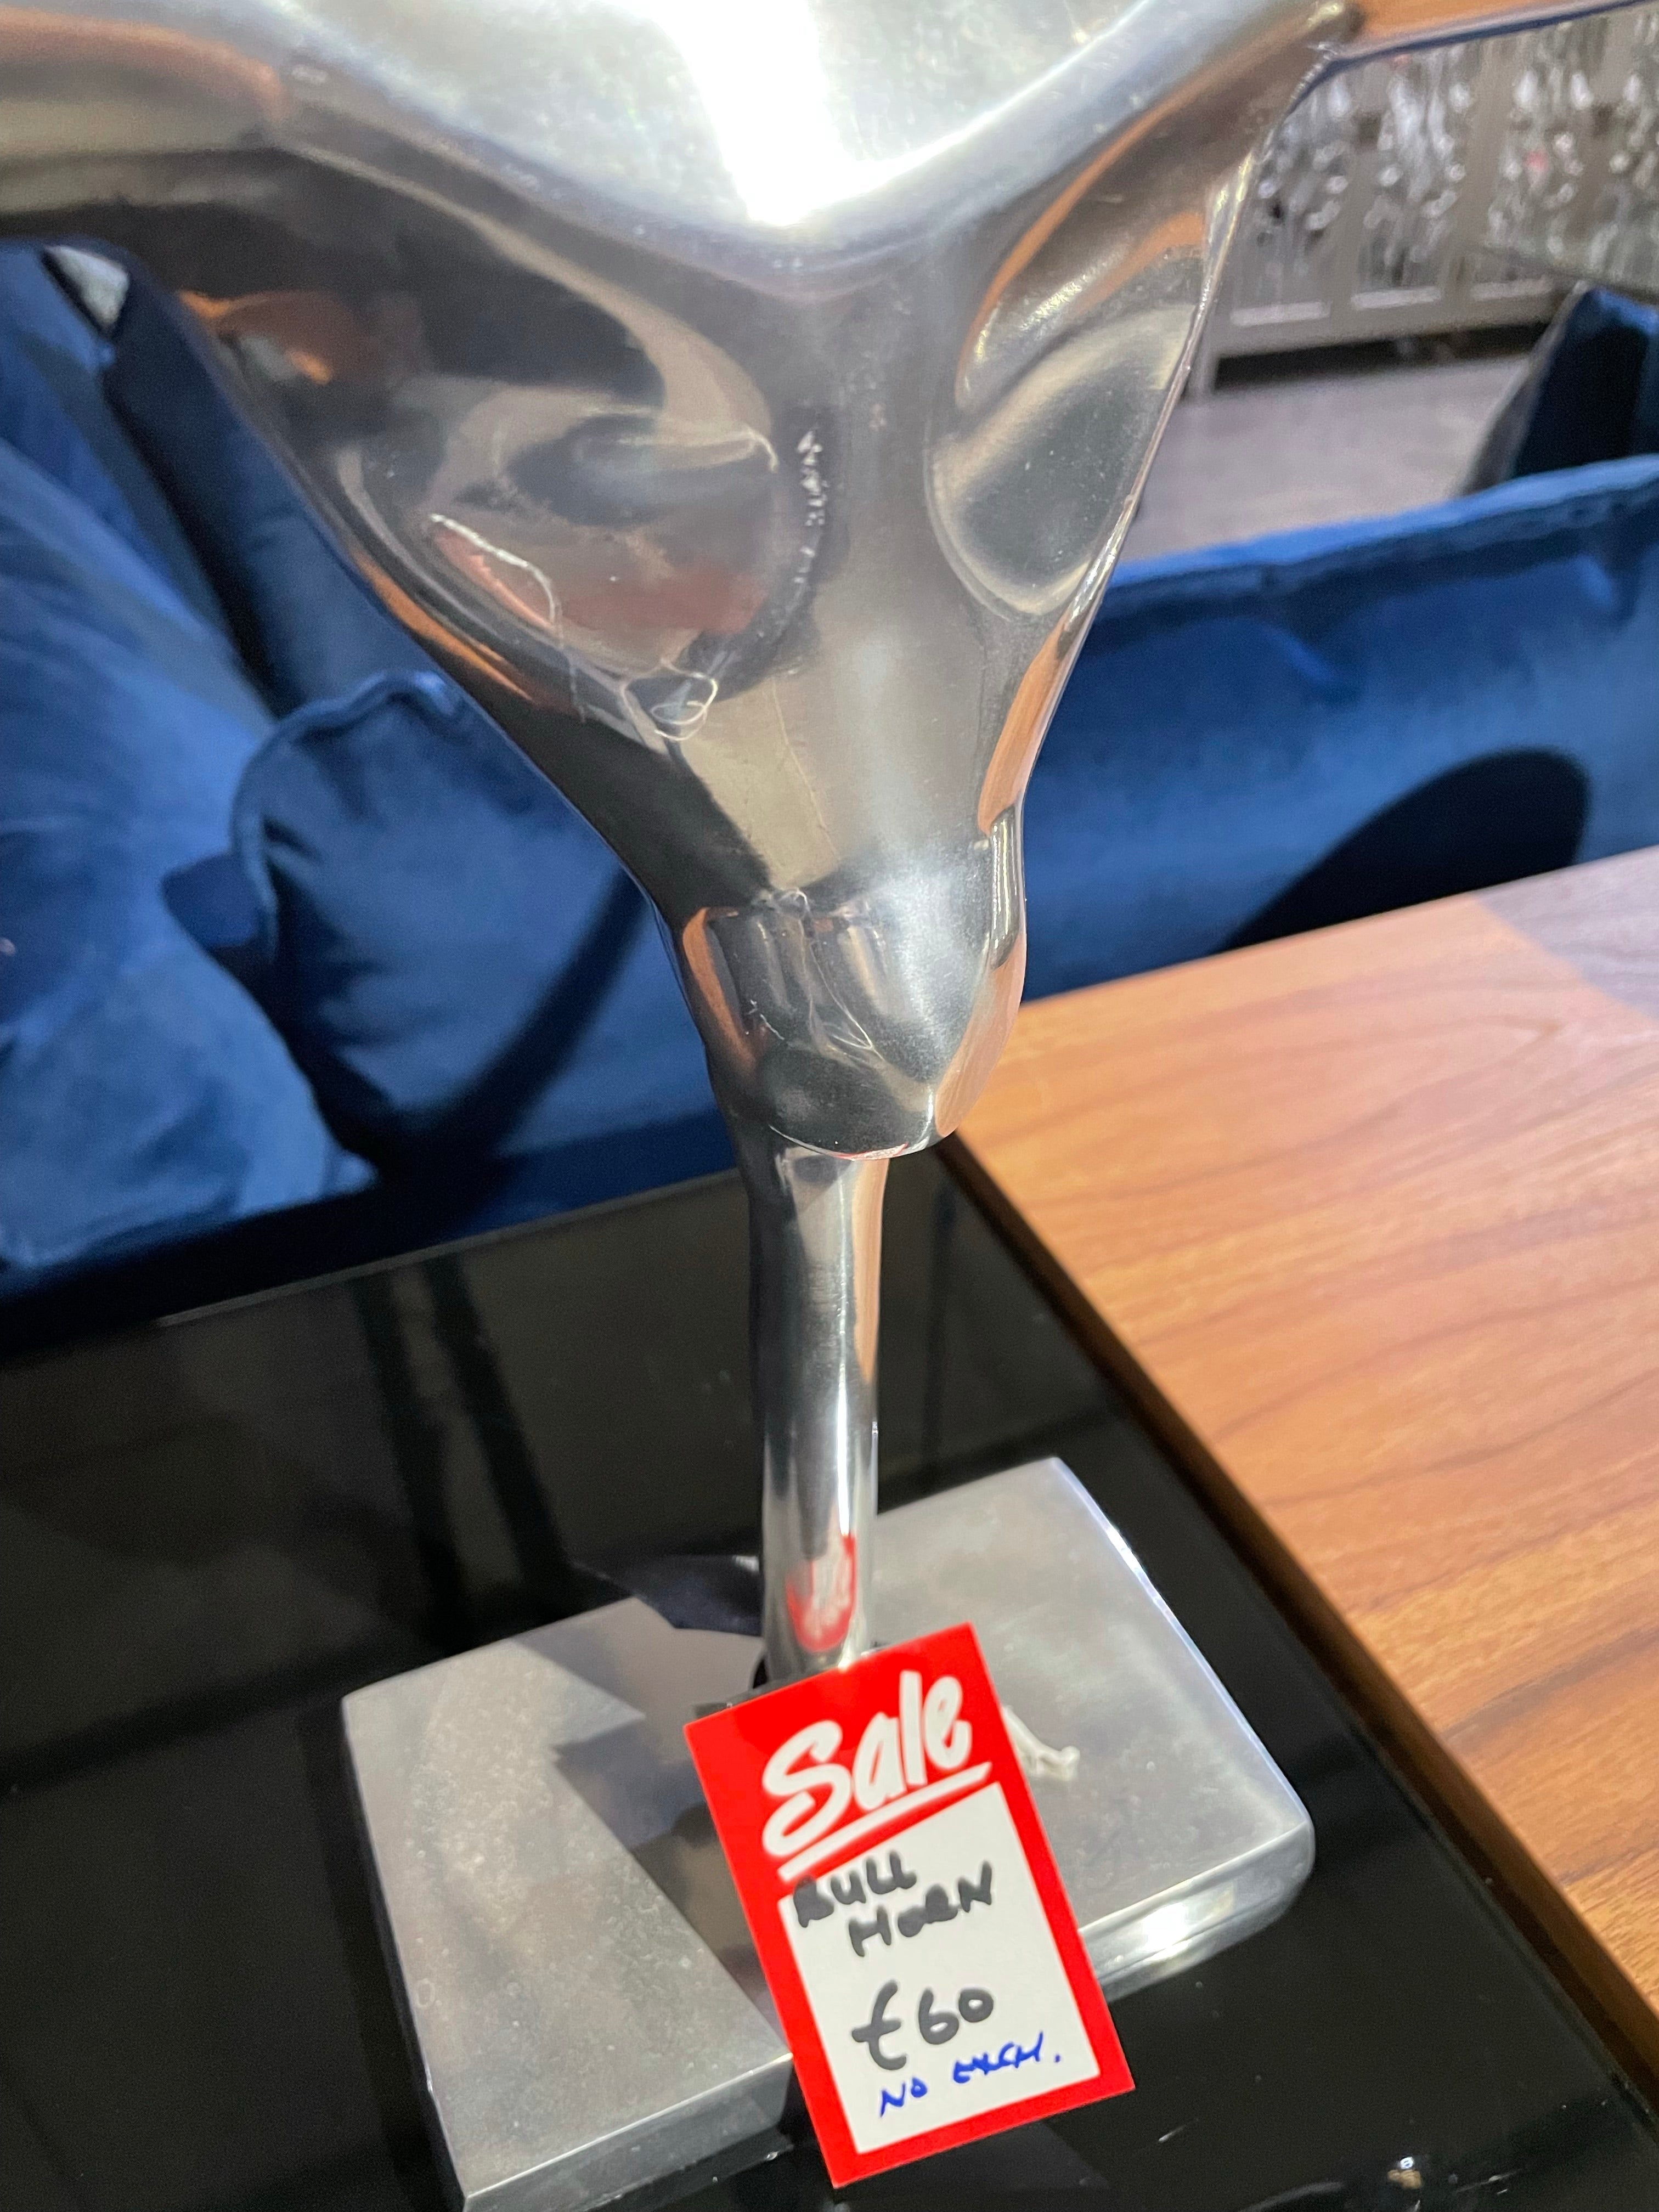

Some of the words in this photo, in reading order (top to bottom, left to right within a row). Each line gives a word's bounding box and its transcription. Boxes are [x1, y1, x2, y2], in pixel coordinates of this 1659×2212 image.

[763, 1670, 972, 1858] Sale
[848, 1860, 992, 1957] HORN
[880, 2077, 928, 2117] NO
